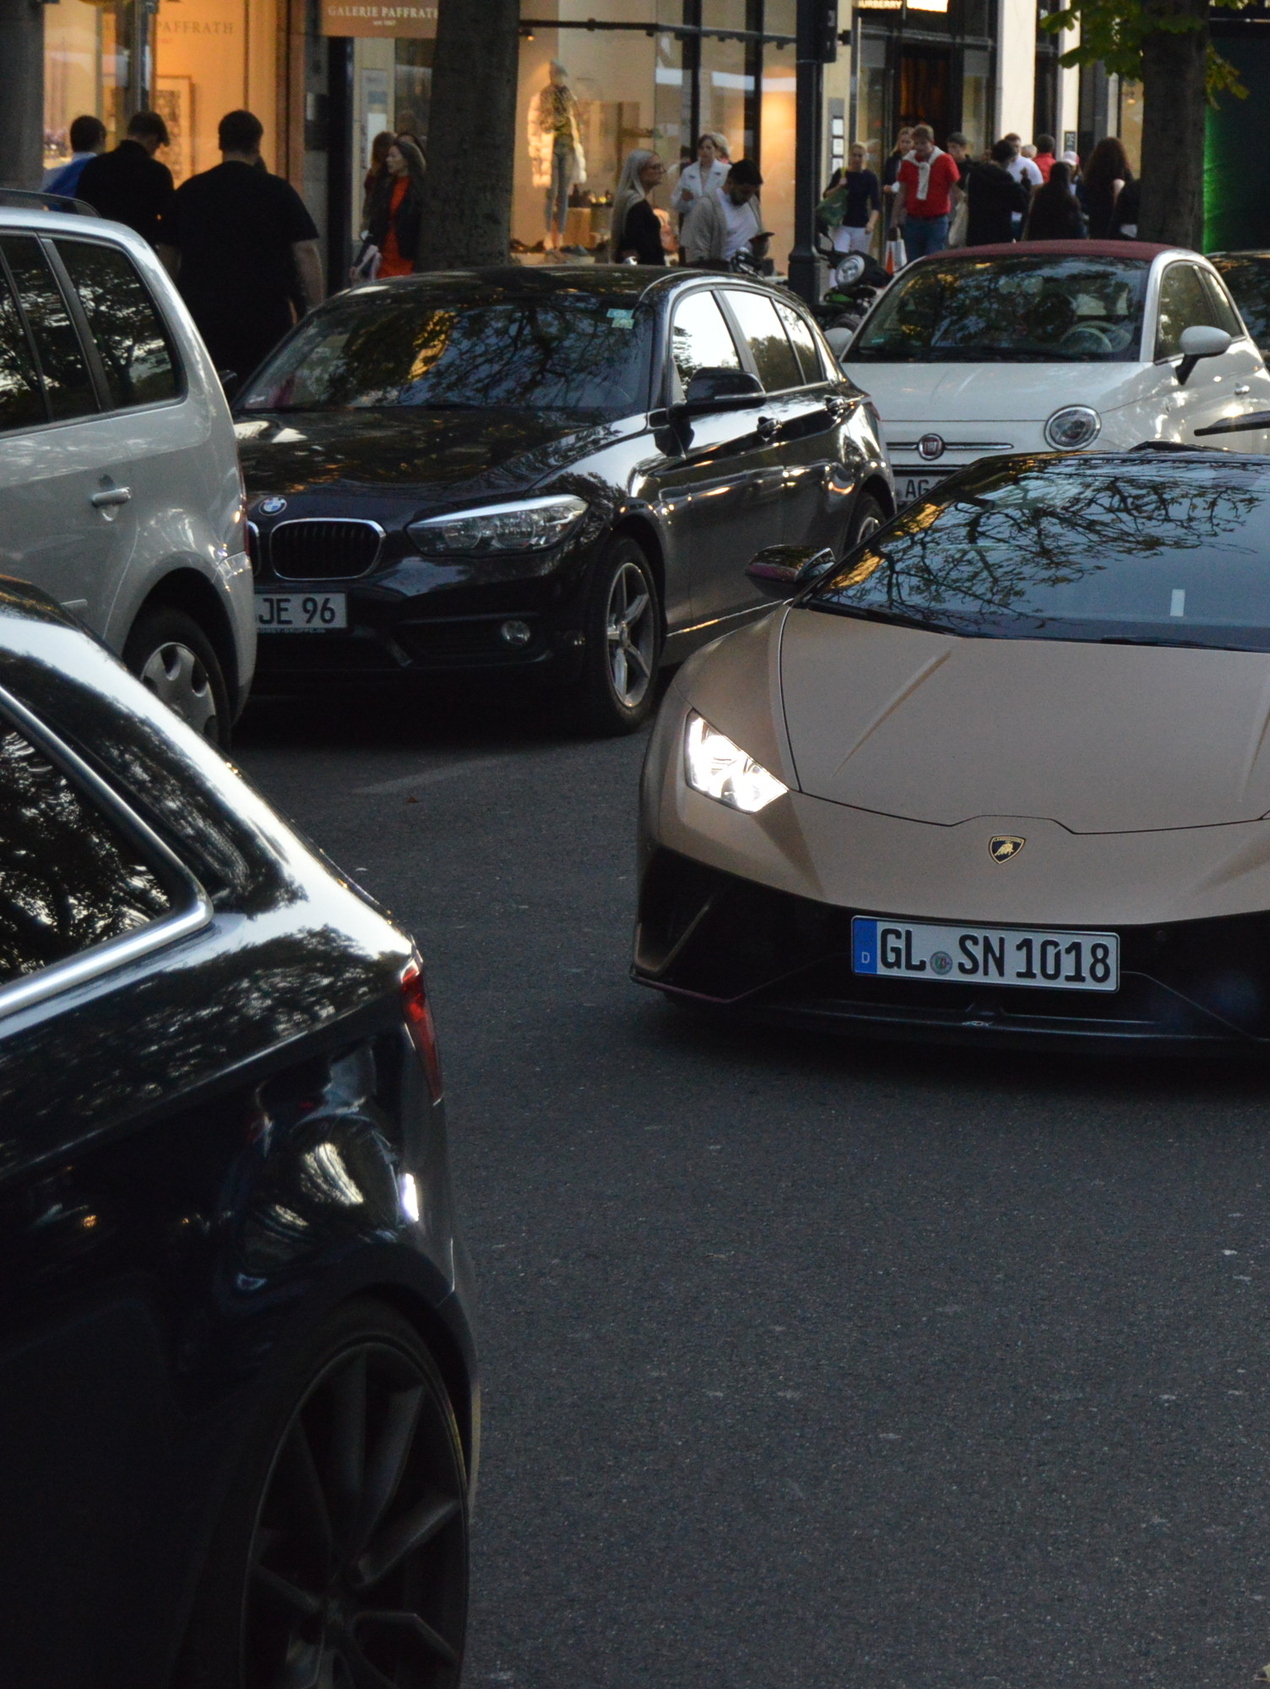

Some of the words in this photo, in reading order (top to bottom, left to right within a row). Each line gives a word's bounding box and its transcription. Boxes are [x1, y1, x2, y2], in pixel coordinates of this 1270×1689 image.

[328, 6, 379, 17] GALERIE
[258, 597, 293, 625] JE
[302, 597, 336, 625] 96
[880, 928, 927, 971] GL
[957, 933, 1005, 977] SN
[1015, 937, 1111, 984] 1018
